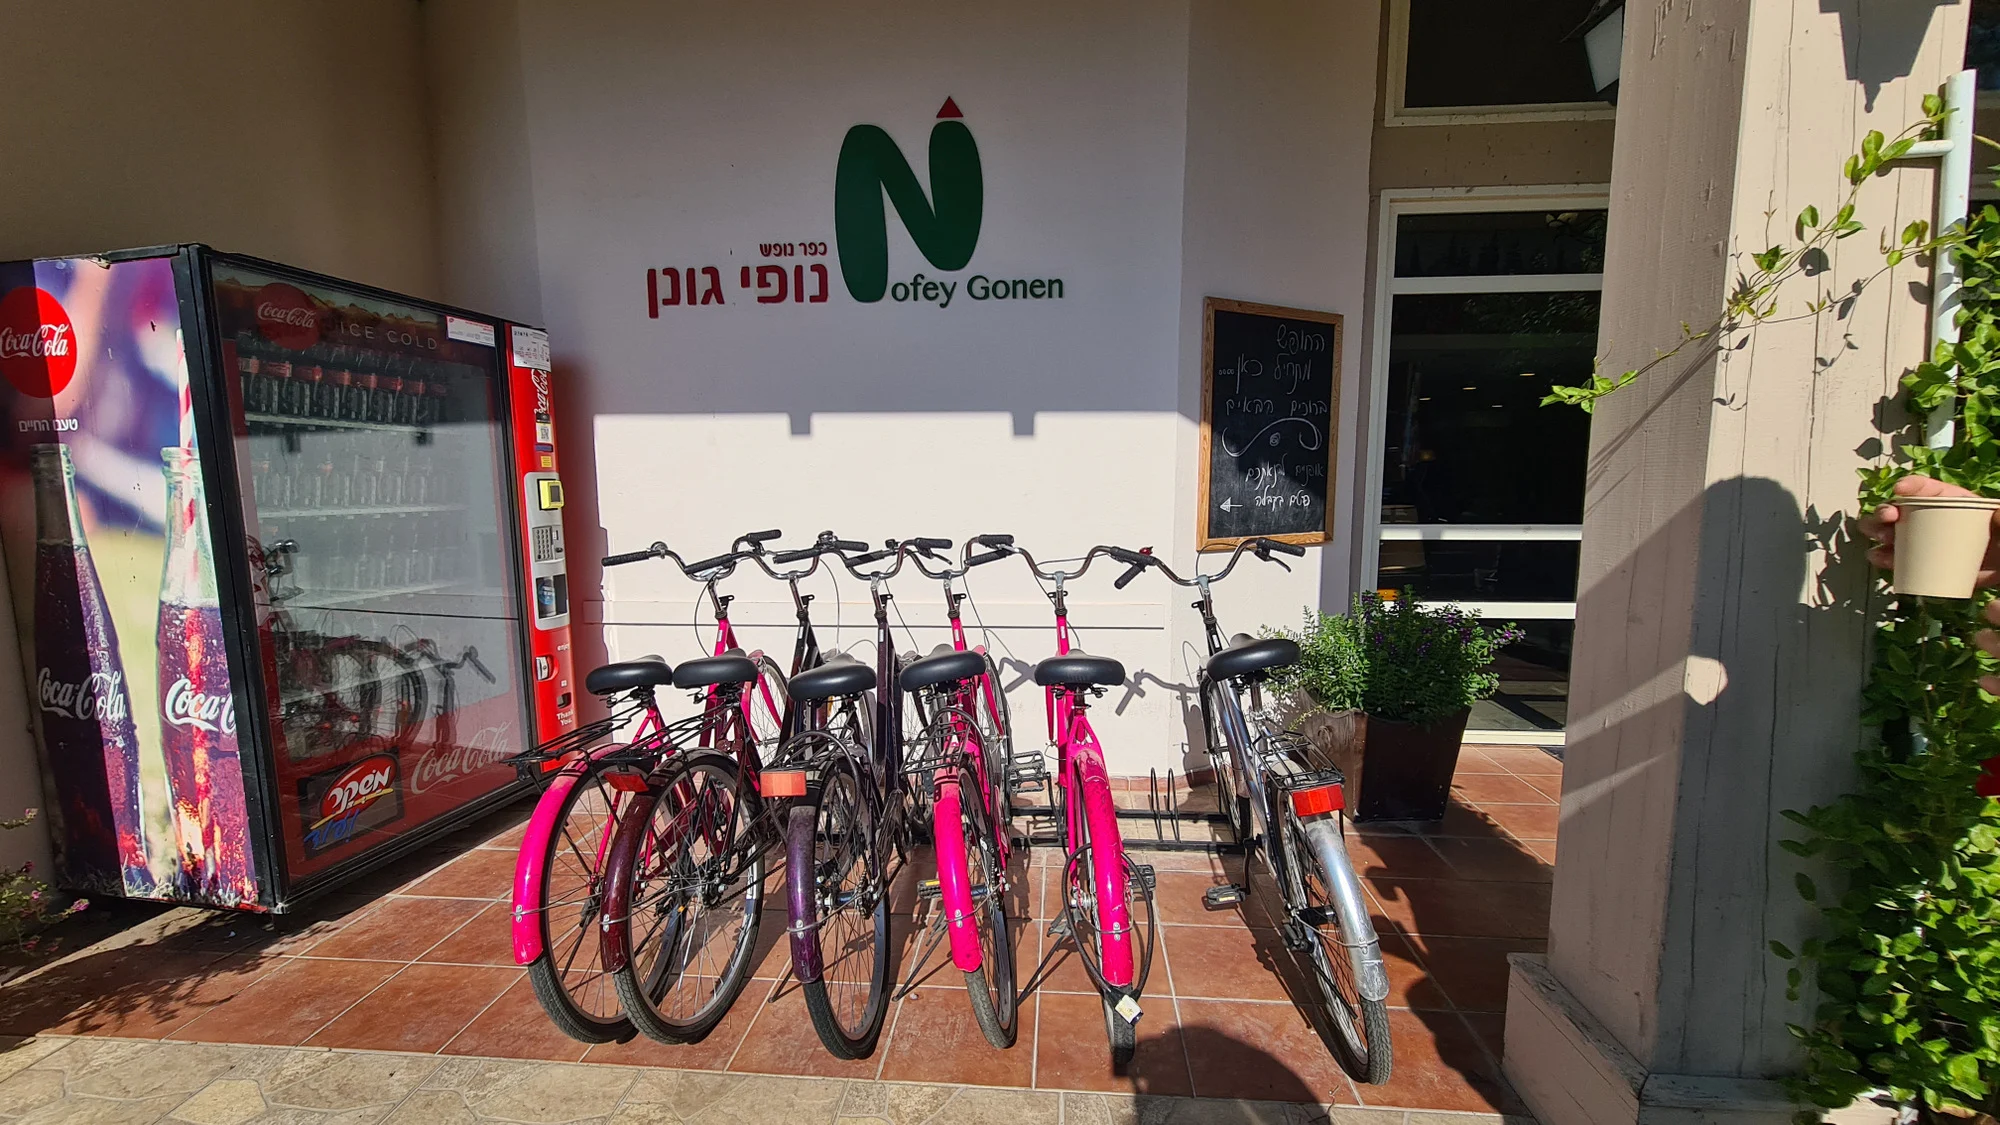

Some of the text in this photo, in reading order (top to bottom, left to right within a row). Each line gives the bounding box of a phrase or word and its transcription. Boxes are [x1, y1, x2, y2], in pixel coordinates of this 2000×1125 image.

[759, 242, 828, 257] כפר נופש
[646, 264, 828, 319] נופי גונן
[966, 275, 1063, 300] Gonen
[258, 302, 316, 329] Coca-Cola
[340, 321, 375, 340] ICE
[386, 331, 438, 350] COLD
[1277, 324, 1325, 355] החופש
[1274, 353, 1312, 394] מתחיל
[1226, 396, 1328, 416] ברוכים הבאים
[18, 418, 79, 432] טעם החיים
[37, 667, 127, 721] Coca-Cola
[410, 721, 511, 794] Coca-Cola
